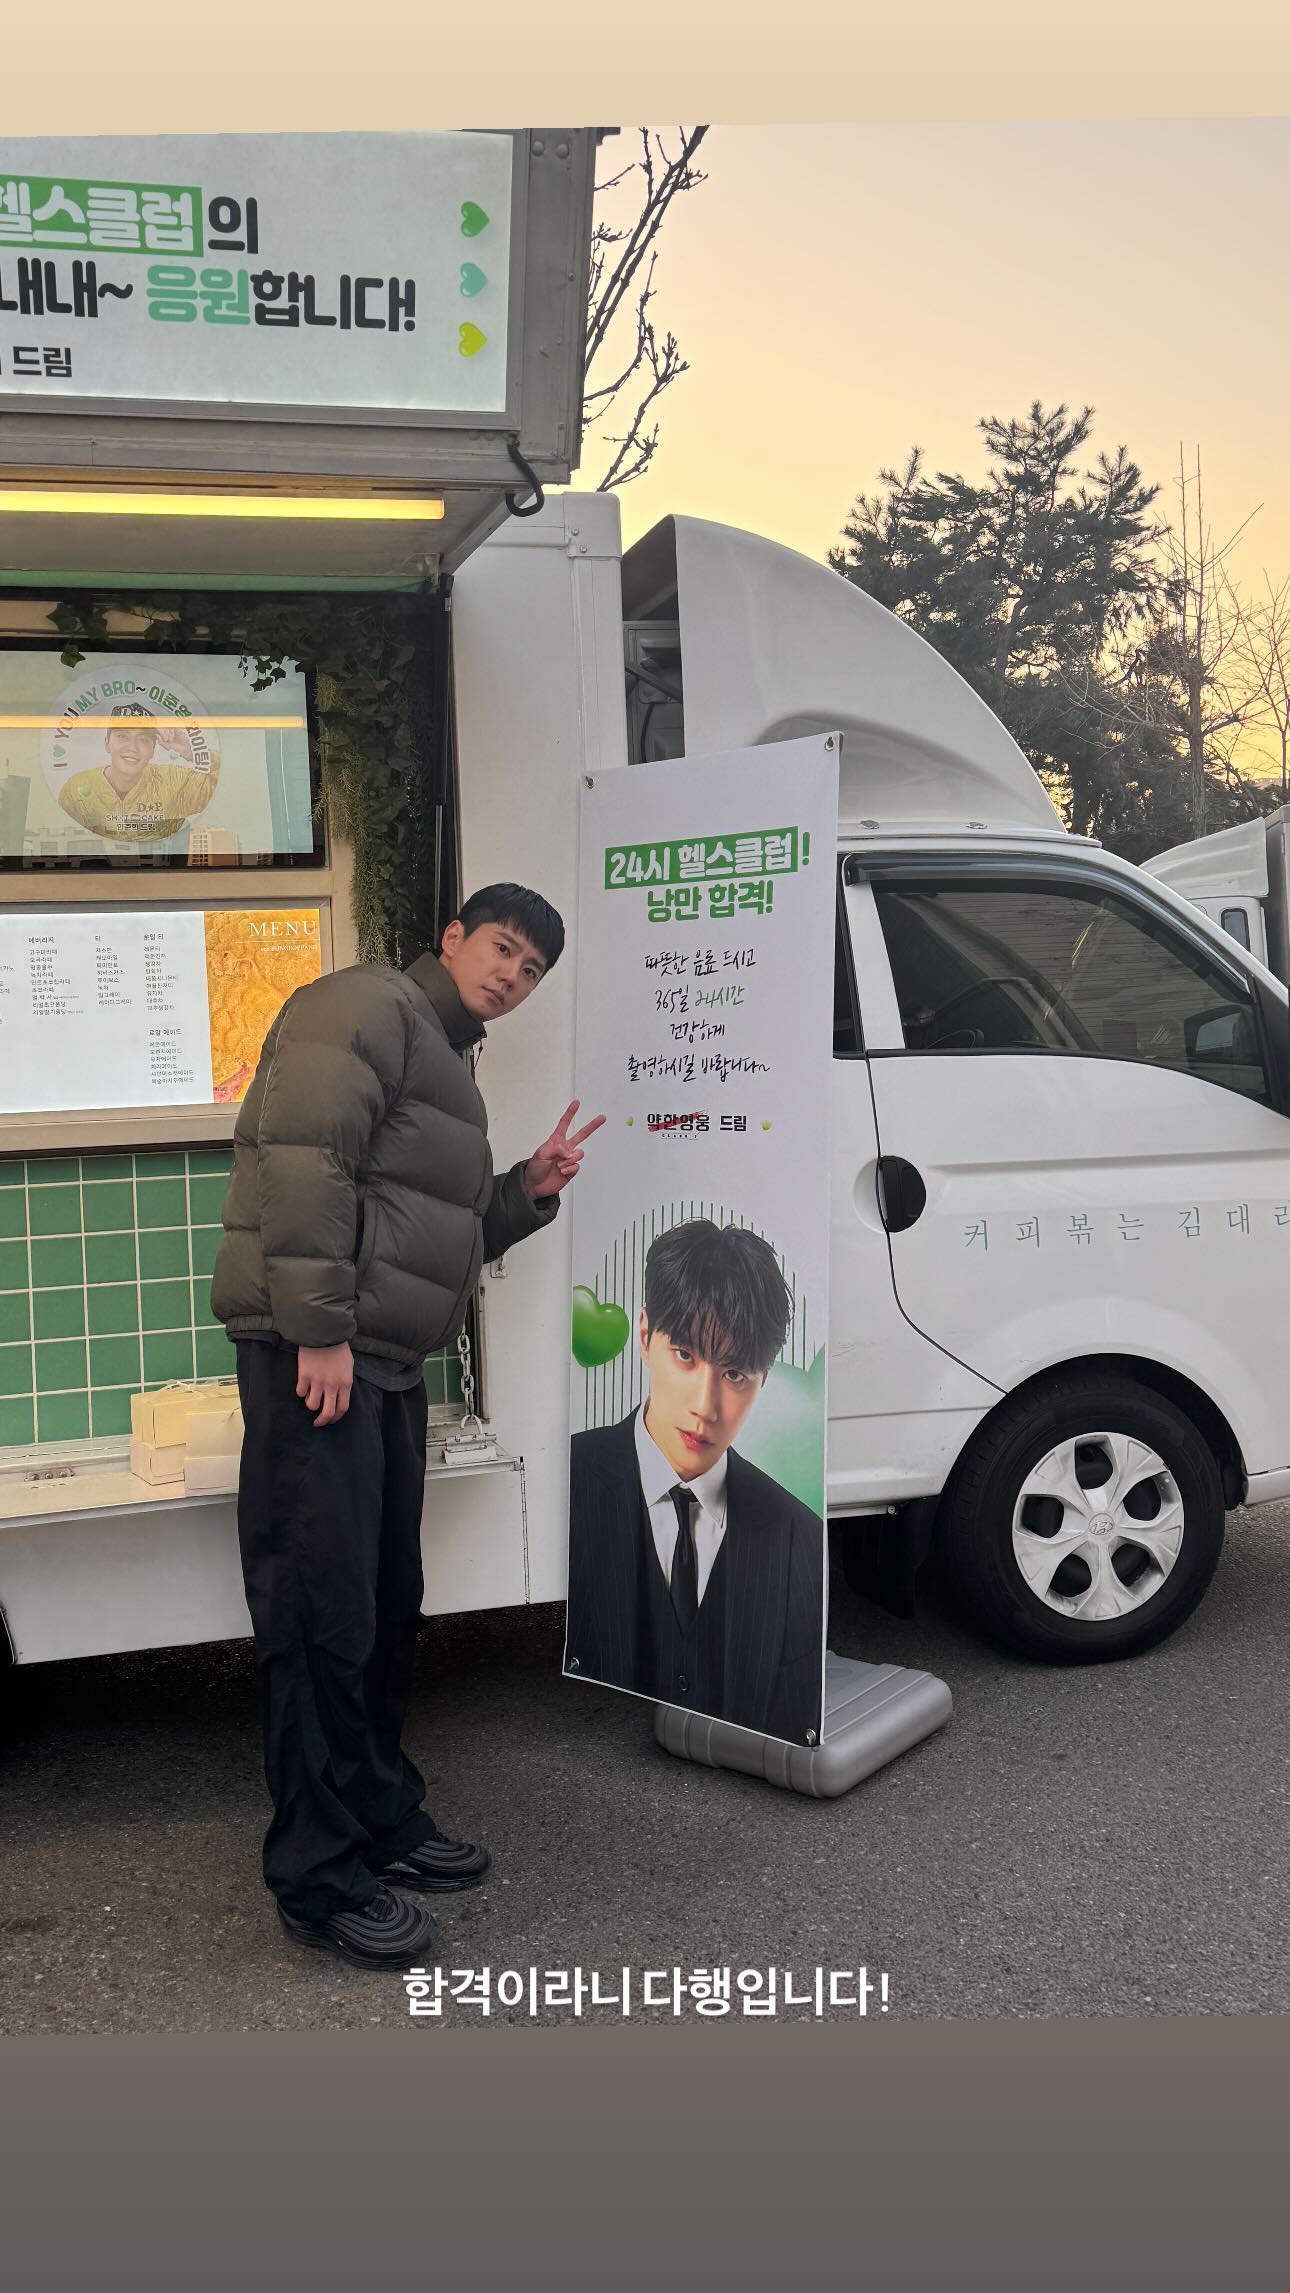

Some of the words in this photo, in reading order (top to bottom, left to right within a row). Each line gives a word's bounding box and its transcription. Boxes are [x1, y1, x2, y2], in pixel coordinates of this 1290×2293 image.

[146, 264, 416, 332] 응원합니다!
[13, 346, 73, 378] 드림
[74, 687, 99, 713] MY
[609, 851, 671, 885] 24시
[678, 831, 811, 879] 헬스클럽!
[647, 886, 702, 923] 낭만
[708, 880, 774, 919] 합격!
[248, 920, 317, 937] MENU
[644, 951, 690, 978] 따뜻한
[692, 949, 719, 976] 음료
[722, 949, 757, 969] 드시고
[655, 985, 690, 1014] 365일
[695, 984, 745, 1009] 24시간
[669, 1022, 727, 1044] 건강하게
[627, 1053, 698, 1083] 촬영하시길
[647, 1112, 710, 1132] 약한영웅
[719, 1115, 747, 1132] 드림
[963, 1212, 1146, 1252] 커피볶는
